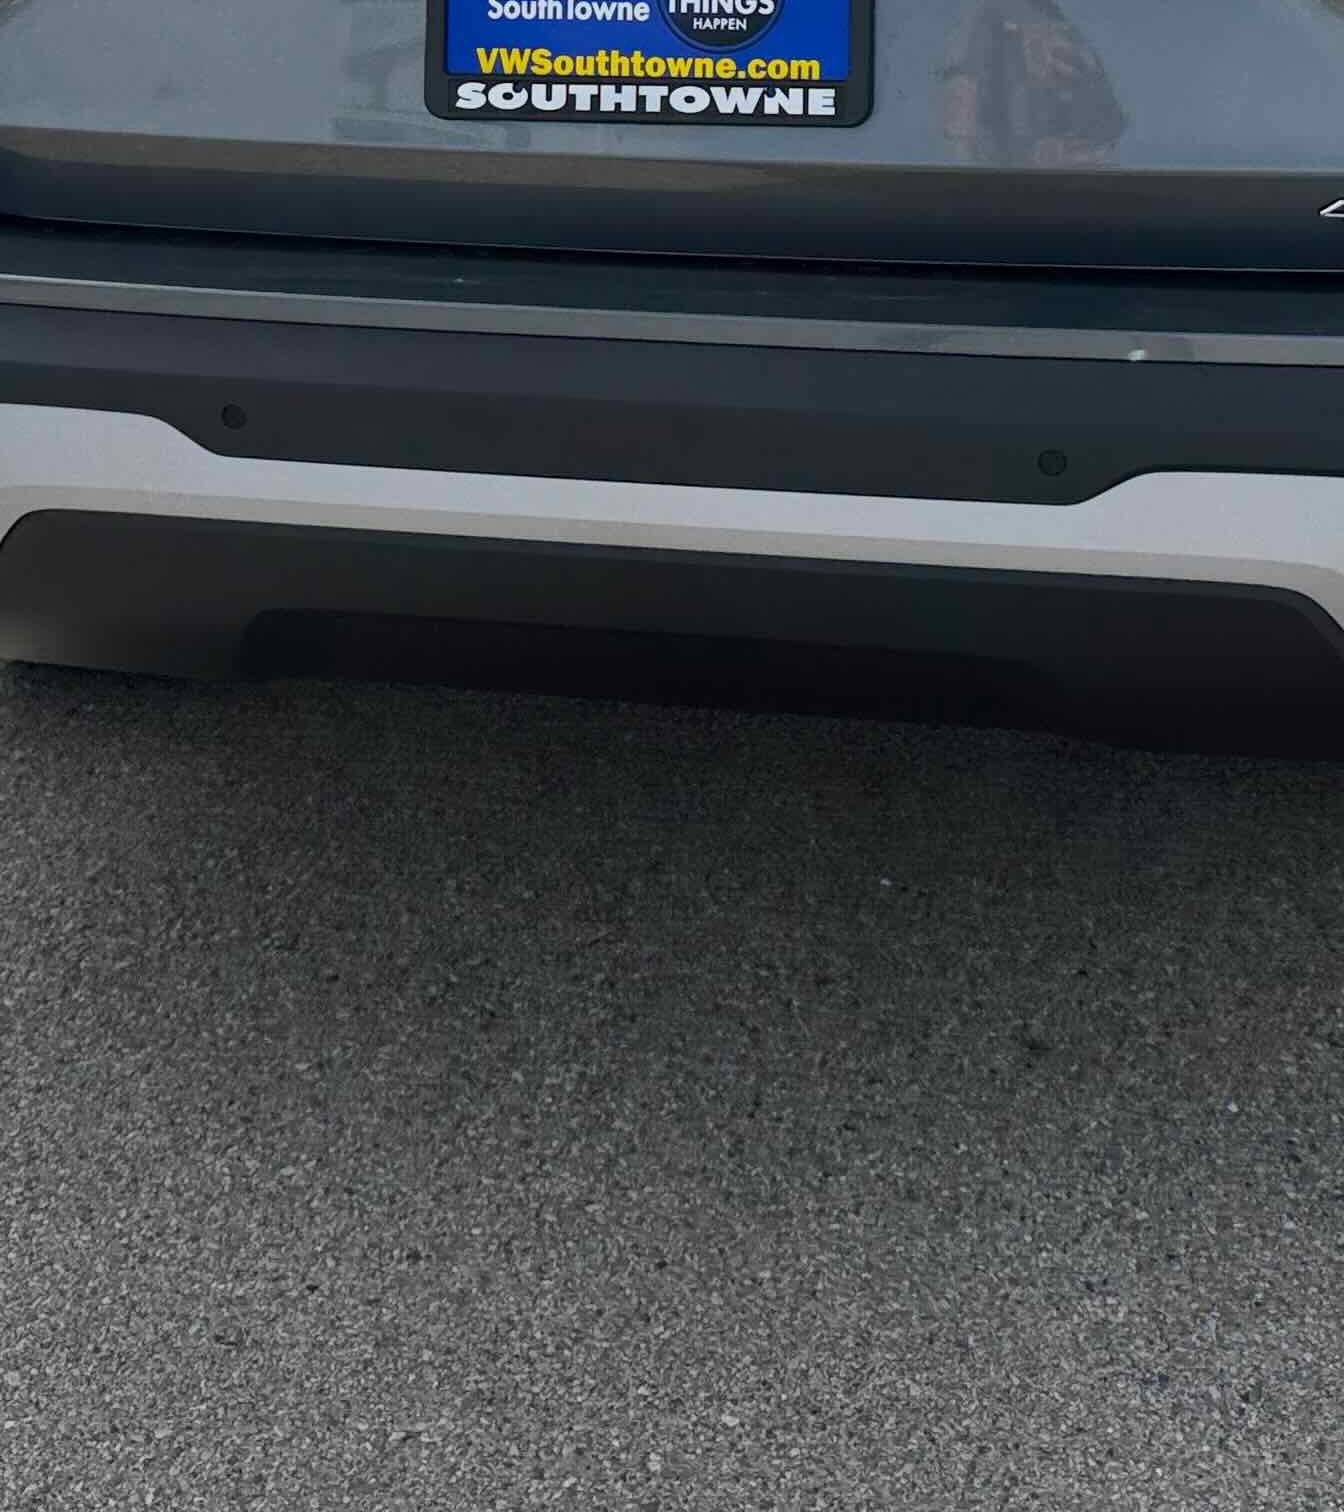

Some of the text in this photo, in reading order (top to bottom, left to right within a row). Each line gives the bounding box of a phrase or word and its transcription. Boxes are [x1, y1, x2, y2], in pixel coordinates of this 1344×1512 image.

[692, 17, 747, 31] HAPPEN
[475, 47, 821, 81] VWSouthtowne.com
[455, 81, 836, 116] SOUTHTOWNE
